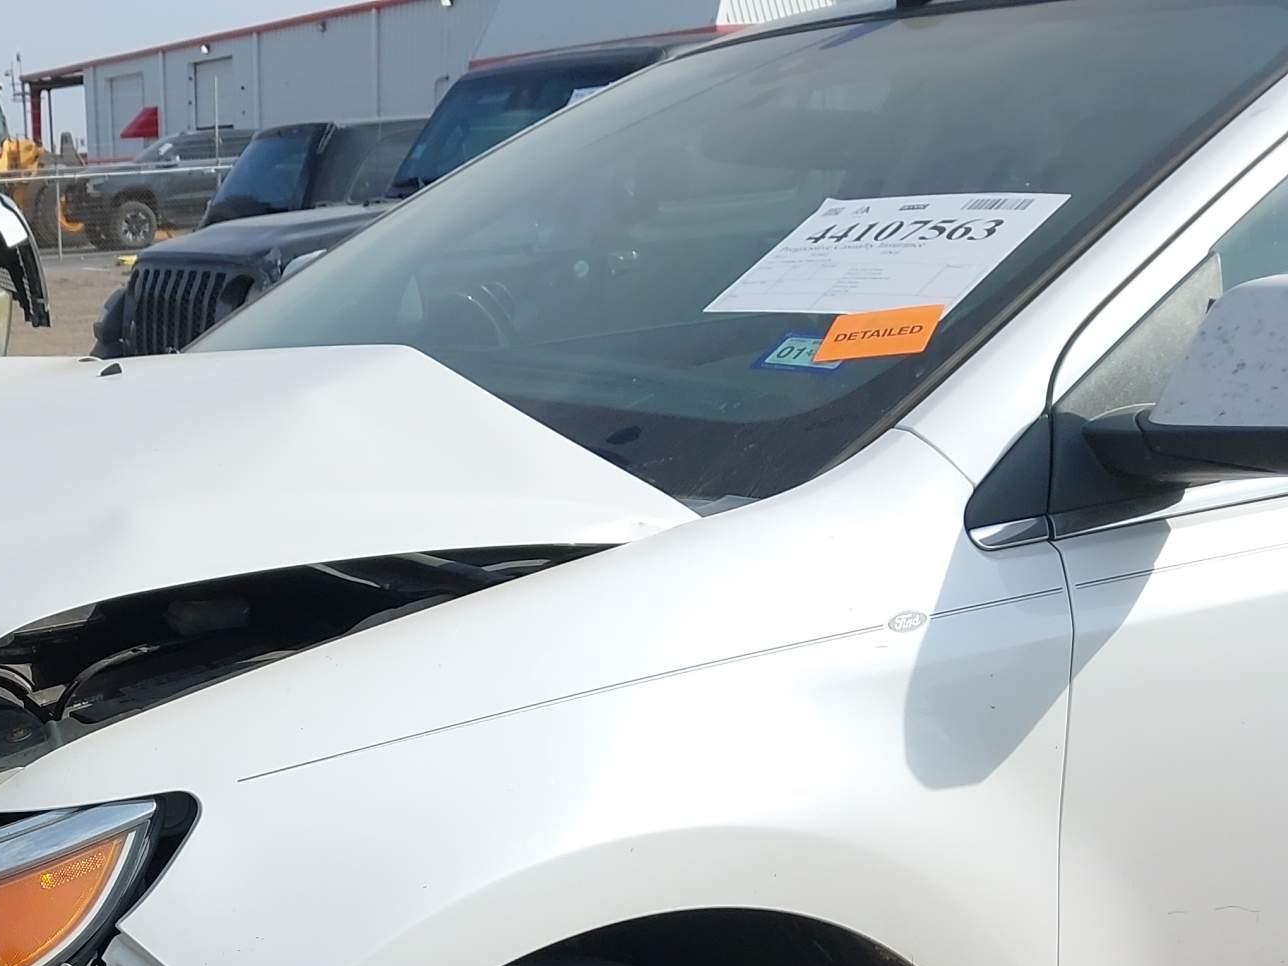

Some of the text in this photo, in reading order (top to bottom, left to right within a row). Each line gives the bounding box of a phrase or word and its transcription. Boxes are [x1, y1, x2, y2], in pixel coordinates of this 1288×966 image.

[805, 218, 1005, 244] 44107563
[833, 324, 924, 343] DETAILED
[893, 612, 921, 630] Ford
